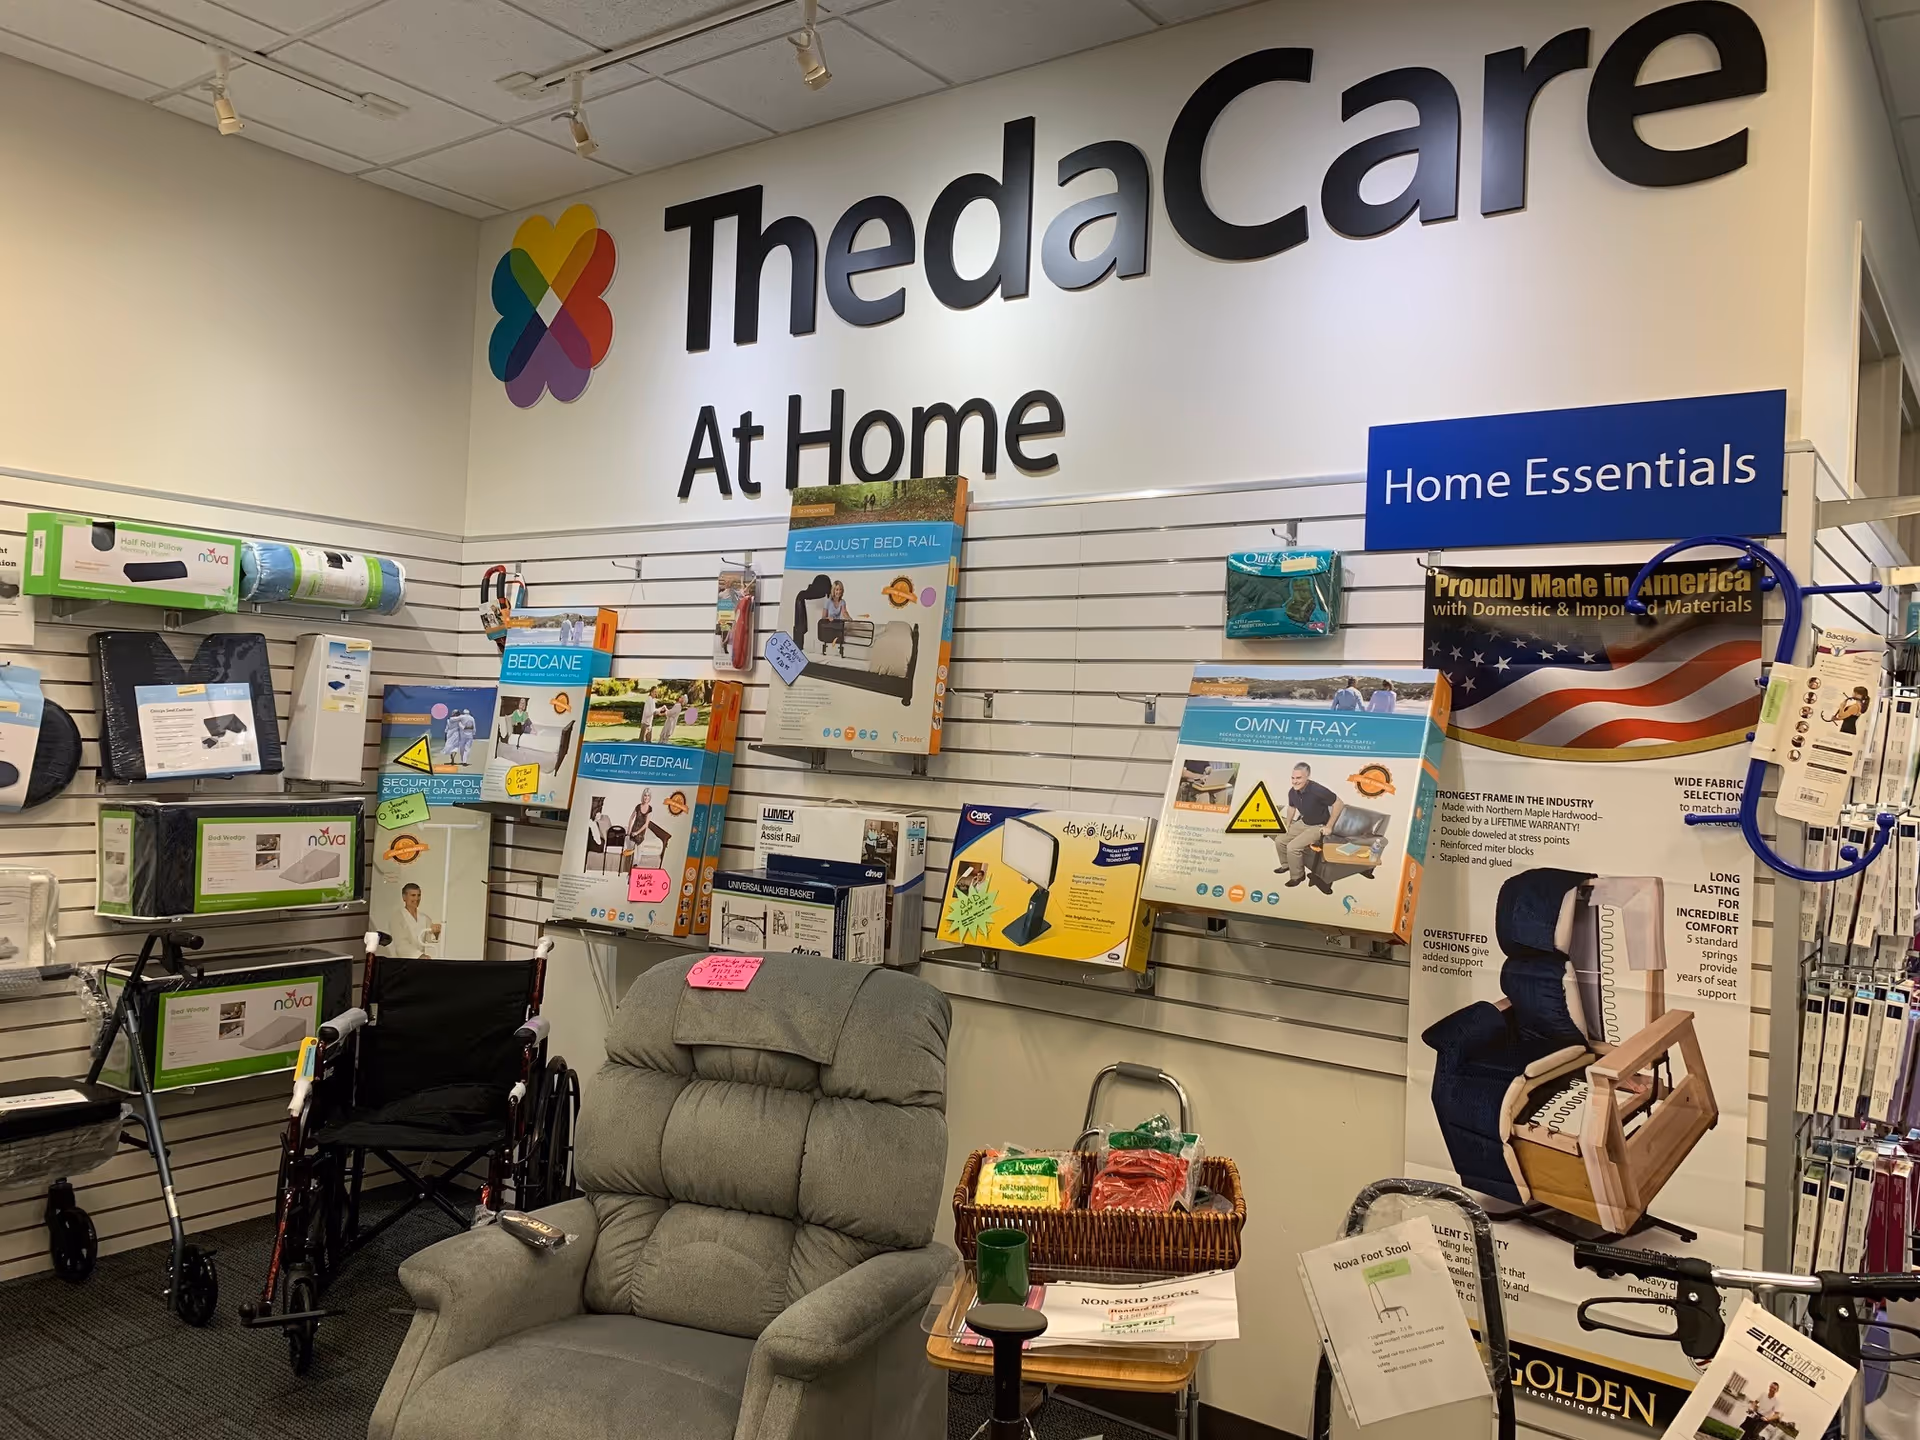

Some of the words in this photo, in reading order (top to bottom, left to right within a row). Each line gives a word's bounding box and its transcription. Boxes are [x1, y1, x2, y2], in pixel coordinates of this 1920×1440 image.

[664, 0, 1768, 353] ThedaCare
[678, 405, 764, 501] At
[785, 388, 1065, 492] Home
[1385, 467, 1511, 505] Home
[1525, 443, 1757, 497] Essentials
[120, 537, 139, 546] Half
[140, 540, 157, 549] Roll
[158, 541, 183, 553] Pillow
[794, 540, 813, 553] EZ
[814, 537, 870, 552] ADJUST
[873, 536, 903, 549] BED
[907, 534, 941, 548] RAIL
[198, 551, 229, 566] nova
[1435, 573, 1526, 600] Proudly
[1531, 573, 1598, 598] Made
[1604, 572, 1630, 597] in
[1638, 567, 1751, 597] America
[1433, 600, 1467, 616] with
[1472, 600, 1551, 617] Domestic
[1556, 601, 1569, 617] &
[1575, 600, 1658, 621] Impord
[1664, 595, 1753, 615] Materials
[507, 653, 583, 671] BEDCANE
[1235, 716, 1289, 734] OMNI
[1296, 719, 1357, 738] TRAY
[583, 752, 638, 766] MOBILITY
[639, 755, 693, 770] BEDRAIL
[381, 786, 391, 794] &
[432, 787, 463, 795] GRAB
[465, 787, 481, 795] BA
[382, 778, 449, 787] SECURITY
[1674, 777, 1703, 788] WIDE
[1705, 779, 1744, 790] FABRIC
[1435, 790, 1481, 802] TRONGEST
[1482, 793, 1513, 804] FRAME
[1515, 794, 1525, 804] IN
[1526, 795, 1545, 806] THE
[1546, 796, 1594, 809] INDUSTRY
[1683, 789, 1743, 802] SELECTION
[762, 807, 795, 821] LUMEX
[1441, 802, 1465, 812] Made
[1466, 803, 1484, 813] with
[1485, 805, 1523, 816] Northern
[1524, 807, 1550, 819] Maple
[1680, 803, 1690, 812] to
[1692, 804, 1723, 814] match
[761, 823, 783, 832] Bedside
[1441, 813, 1470, 825] backed
[1471, 815, 1482, 826] by
[1490, 817, 1527, 829] LIFETIME
[1528, 819, 1580, 832] WARRANTY!
[760, 831, 784, 842] Assist
[785, 832, 801, 843] Rail
[1062, 821, 1084, 839] day
[1099, 822, 1125, 841] light
[1440, 826, 1470, 838] Double
[1471, 829, 1507, 841] doweled
[1508, 832, 1517, 841] at
[1518, 833, 1542, 843] stress
[1543, 835, 1571, 846] points
[308, 834, 346, 846] nova
[1440, 839, 1483, 852] Reinforced
[1484, 844, 1506, 854] miter
[1507, 845, 1535, 856] blocks
[1439, 852, 1470, 865] Stapled
[1471, 854, 1487, 866] and
[1488, 856, 1513, 868] glued
[1709, 872, 1740, 884] LONG
[728, 880, 762, 893] UNIVERSAL
[762, 884, 789, 897] WALKER
[789, 888, 816, 900] BASKET
[1693, 883, 1740, 897] LASTING
[1718, 899, 1740, 910] FOR
[1676, 907, 1739, 923] INCREDIBLE
[1423, 928, 1488, 944] OVERSTUFFED
[1685, 921, 1739, 936] COMFORT
[1422, 940, 1470, 954] CUSHIONS
[1471, 946, 1490, 957] give
[1686, 934, 1693, 944] 5
[1694, 935, 1738, 949] standard
[1422, 952, 1449, 963] added
[1450, 956, 1484, 967] support
[1701, 949, 1738, 964] springs
[1421, 964, 1438, 973] and
[1439, 966, 1473, 978] comfort
[1699, 962, 1738, 975] provide
[1676, 972, 1702, 983] years
[1704, 974, 1715, 985] of
[1716, 978, 1737, 988] seat
[273, 994, 313, 1011] nova
[1697, 988, 1737, 1001] support
[1432, 1224, 1462, 1240] LLENT
[1333, 1257, 1360, 1272] Nova
[1360, 1249, 1384, 1264] Foot
[1384, 1241, 1412, 1257] Stool
[1508, 1267, 1526, 1280] that
[1512, 1282, 1530, 1293] and
[1081, 1297, 1149, 1306] NON-SKID
[1152, 1289, 1200, 1303] SOCKS
[1658, 1305, 1668, 1315] of
[1760, 1334, 1794, 1361] FREE
[1525, 1386, 1617, 1421] technologies
